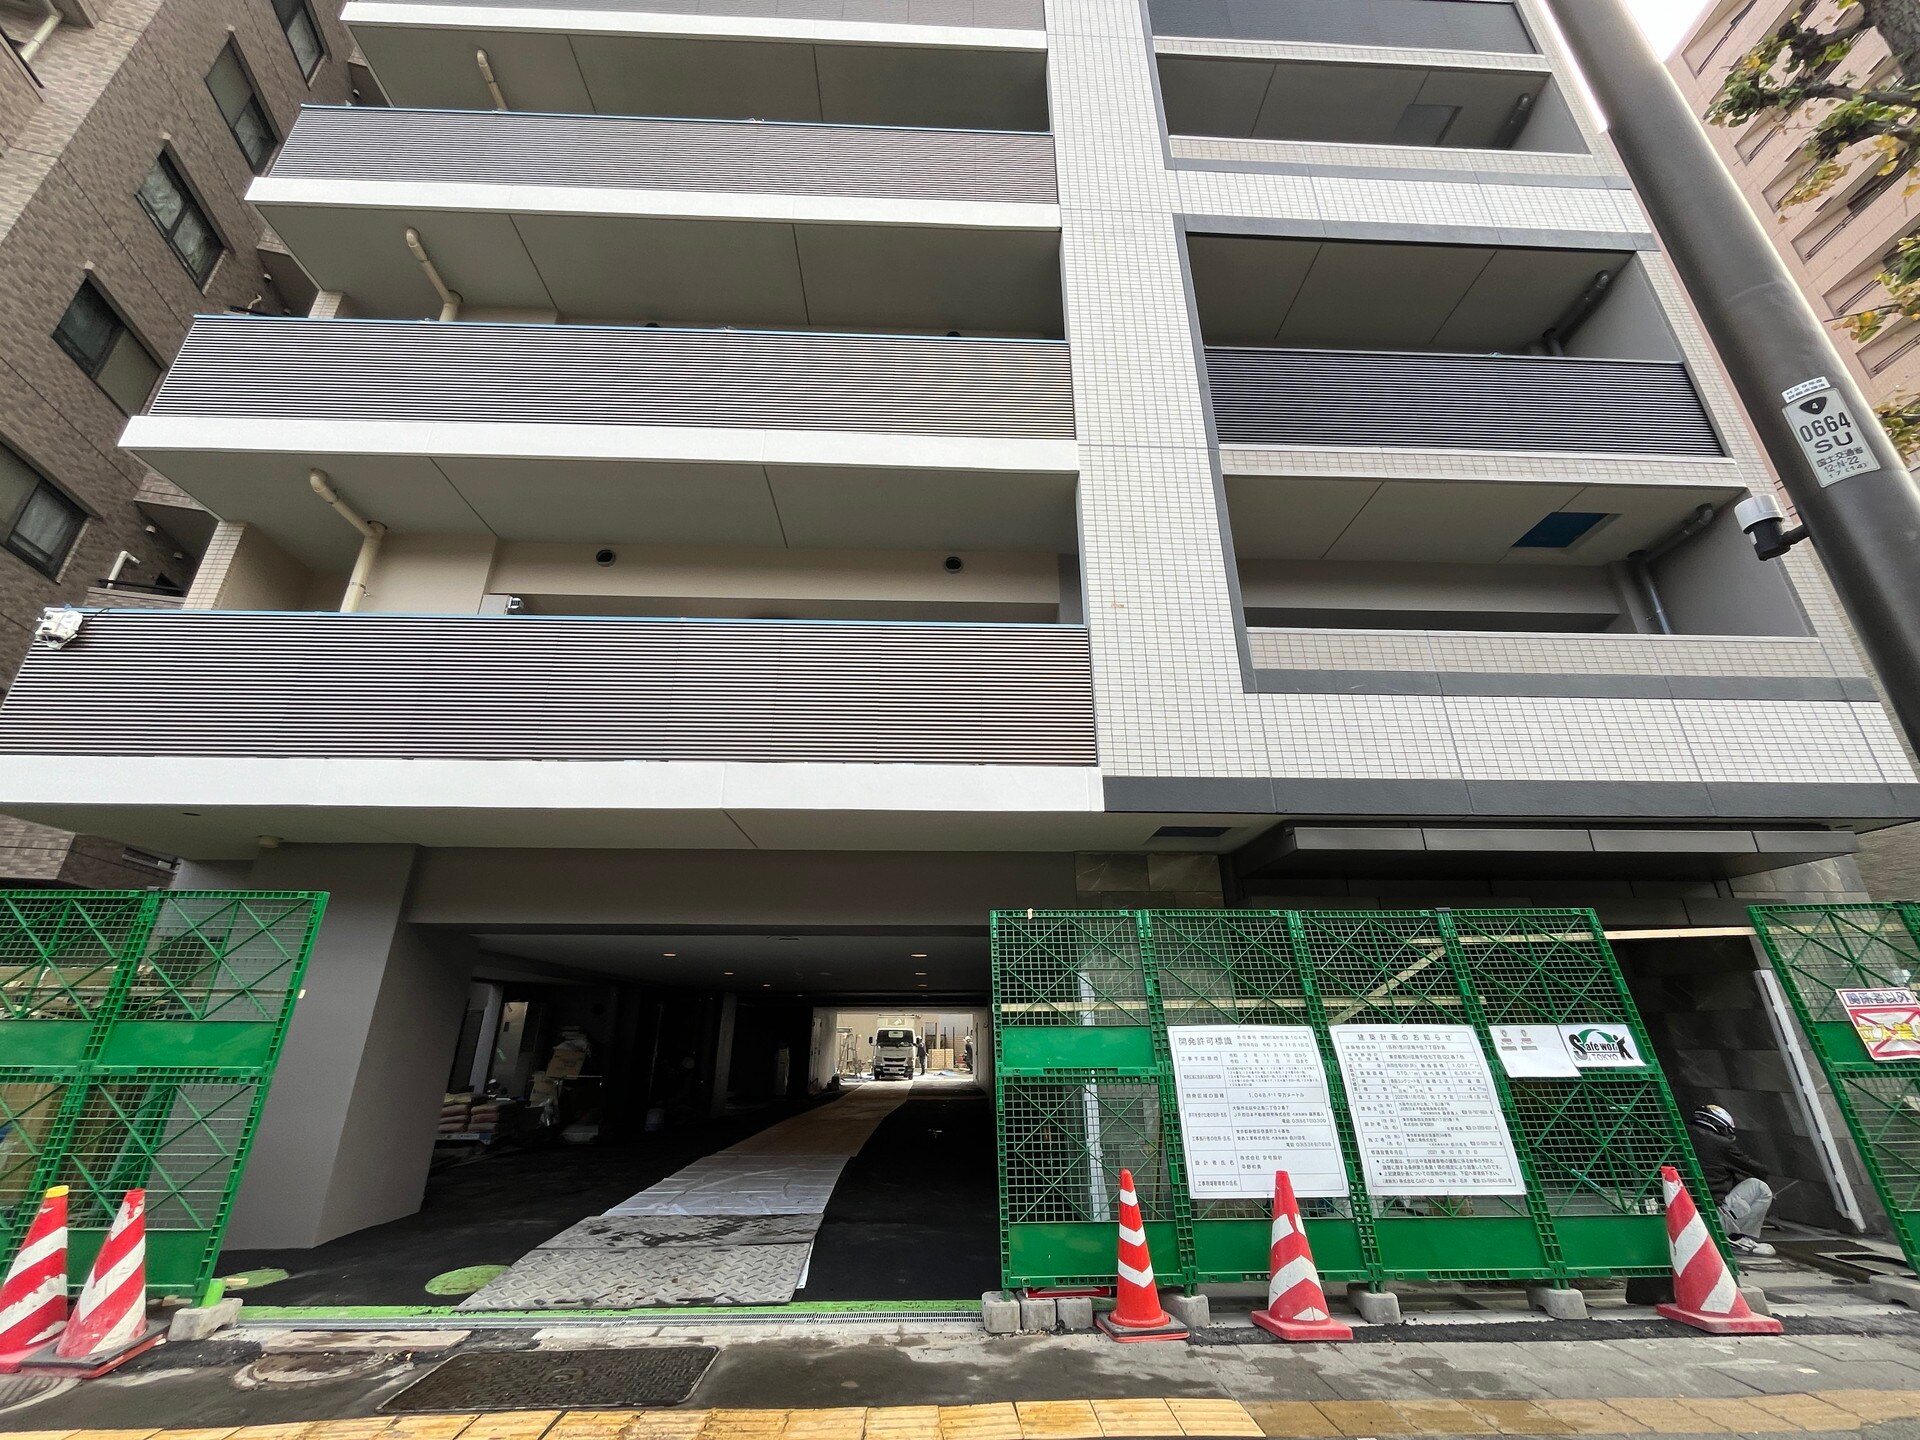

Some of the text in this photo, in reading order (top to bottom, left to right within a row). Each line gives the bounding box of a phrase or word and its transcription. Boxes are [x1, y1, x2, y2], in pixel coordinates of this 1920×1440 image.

[1799, 412, 1851, 442] 0664
[1814, 431, 1853, 454] SU
[1816, 447, 1863, 467] 国土交通省
[1824, 456, 1860, 473] 12-N-22
[1846, 992, 1910, 1004] 関係者以外
[1178, 1037, 1232, 1046] 開発許可標識
[1858, 1023, 1920, 1042] 立入禁
